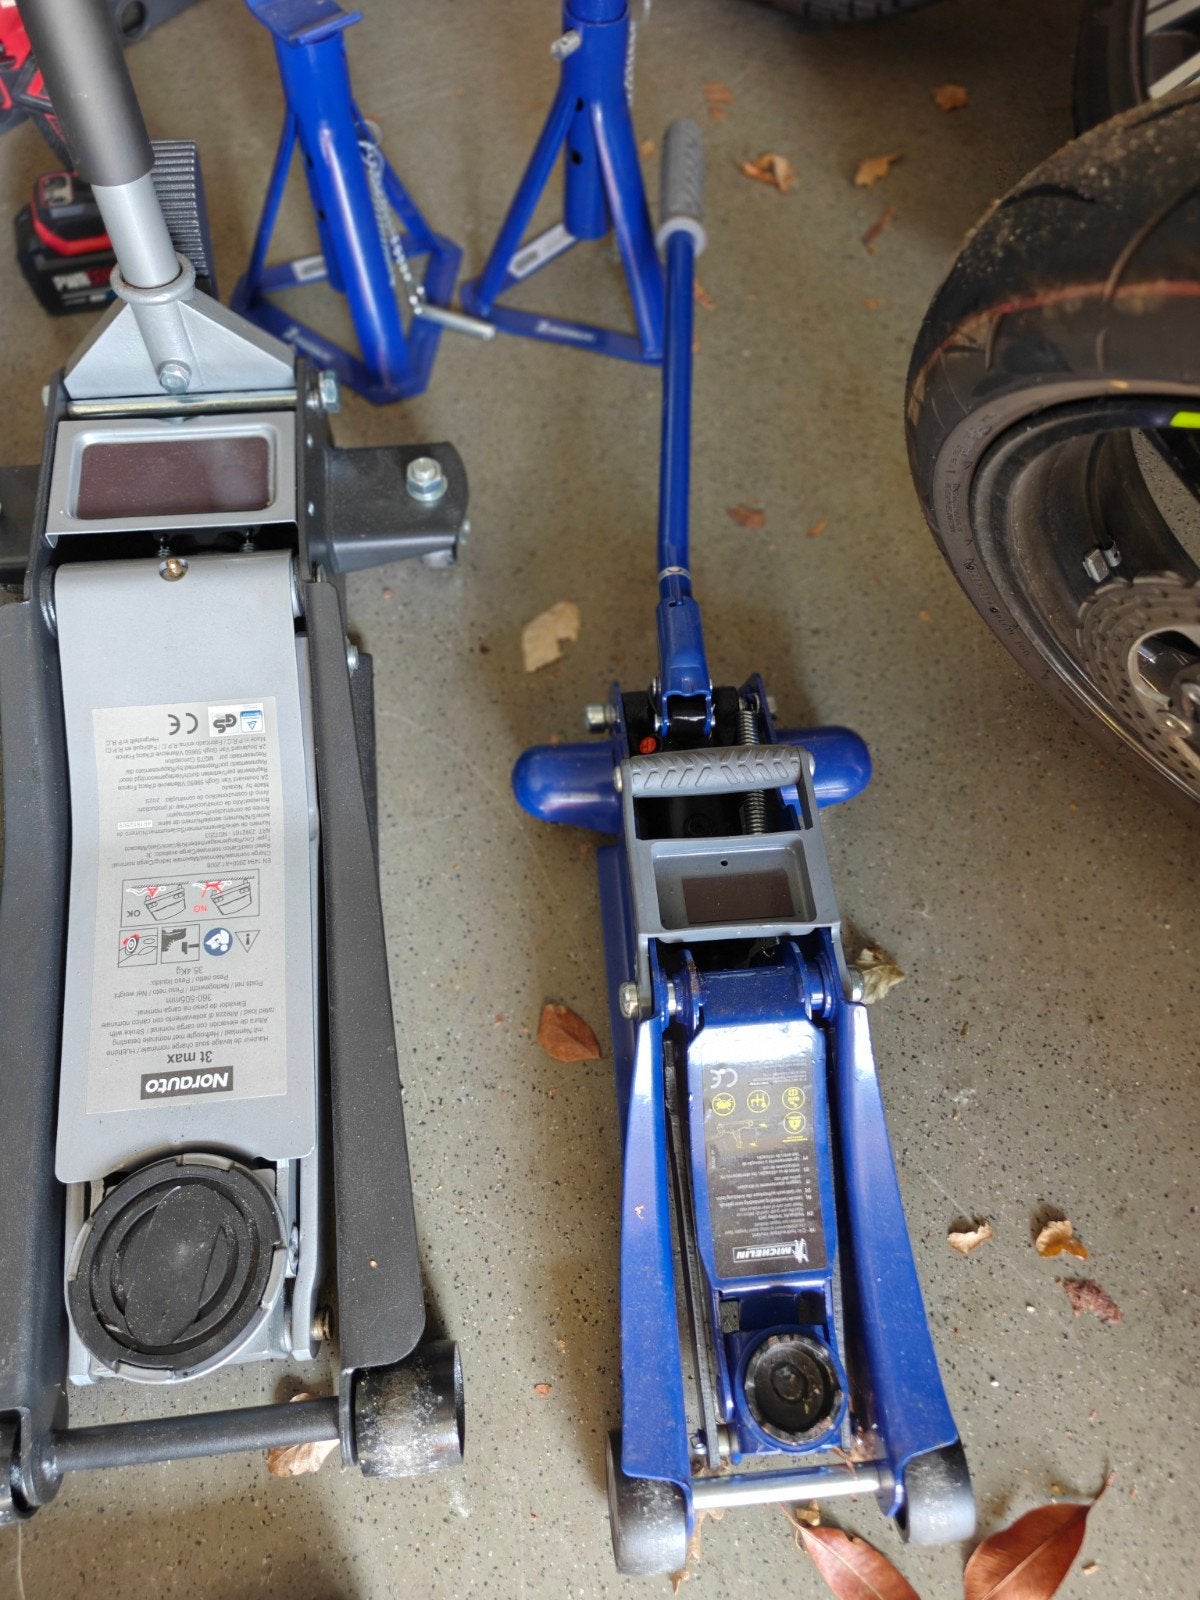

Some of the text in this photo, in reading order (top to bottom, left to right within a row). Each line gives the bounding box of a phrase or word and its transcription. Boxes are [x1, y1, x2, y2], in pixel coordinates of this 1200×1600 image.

[168, 712, 198, 736] CE
[214, 713, 237, 734] GS
[127, 904, 207, 918] NO OK
[177, 964, 204, 976] 35.4Kg
[166, 993, 212, 1005] 360-505mm
[125, 1028, 145, 1036] Stroke
[177, 1022, 194, 1030] carga
[143, 1035, 171, 1043] nominale
[212, 1038, 232, 1047] levage
[244, 1035, 269, 1044] Hauteur
[141, 1045, 170, 1053] nominale
[172, 1041, 193, 1050] charge
[167, 1051, 212, 1064] 3t max
[146, 1072, 228, 1094] Norauto
[710, 1067, 738, 1088] CE
[737, 1247, 791, 1259] MICHELIN
